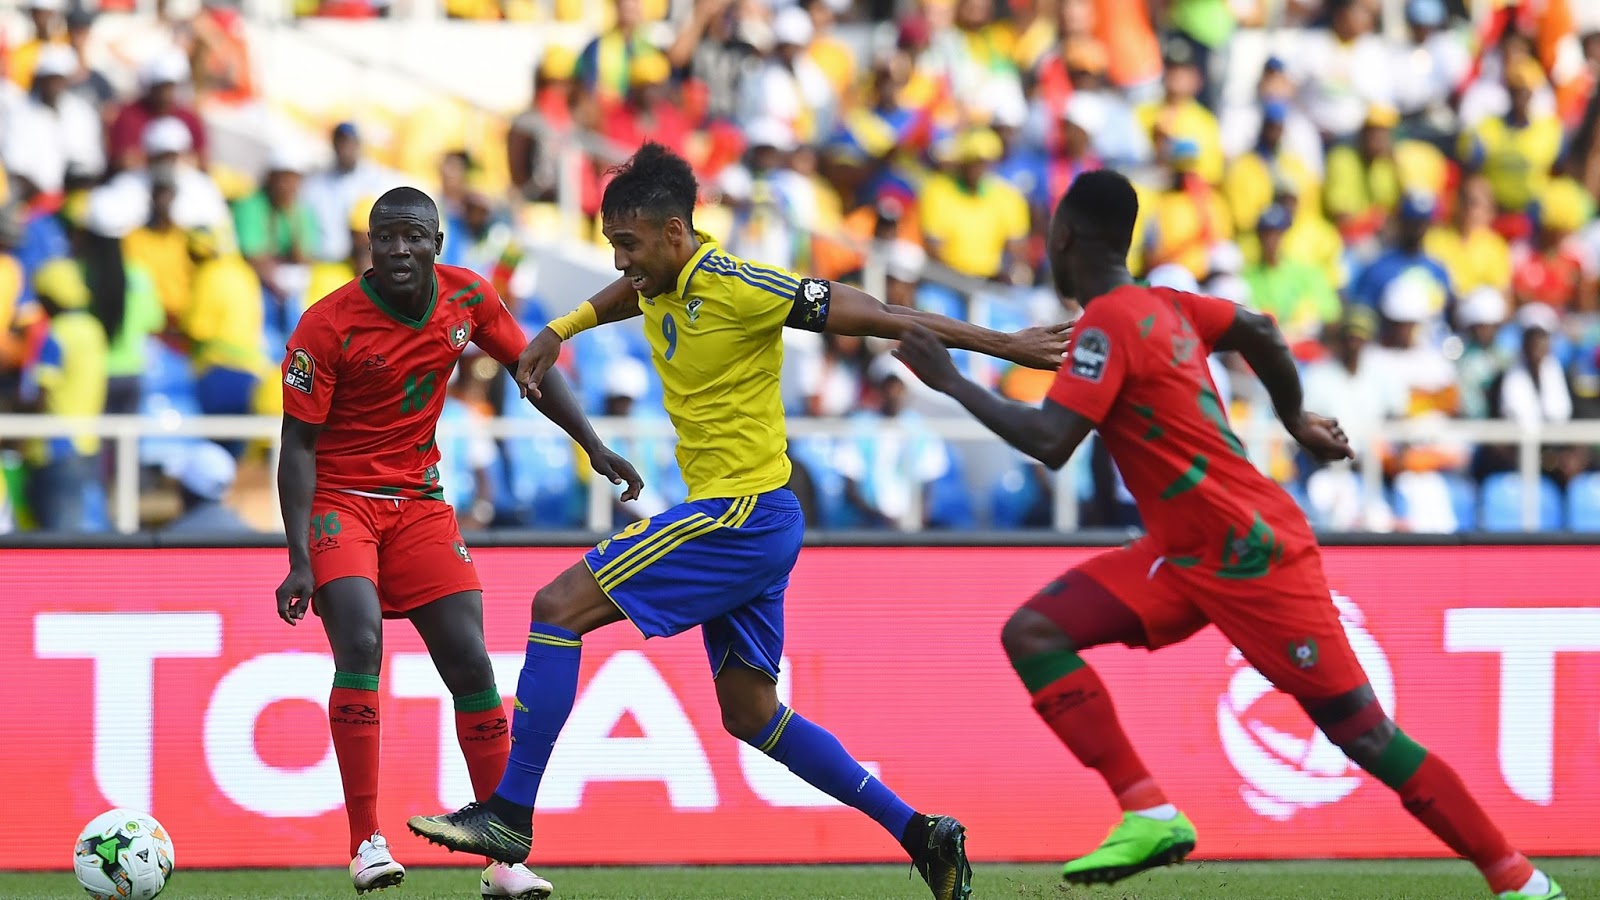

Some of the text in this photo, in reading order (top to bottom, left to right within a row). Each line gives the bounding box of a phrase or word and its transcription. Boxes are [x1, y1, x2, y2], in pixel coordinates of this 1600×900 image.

[662, 312, 677, 361] 9
[400, 371, 436, 413] 16
[312, 511, 342, 540] 16
